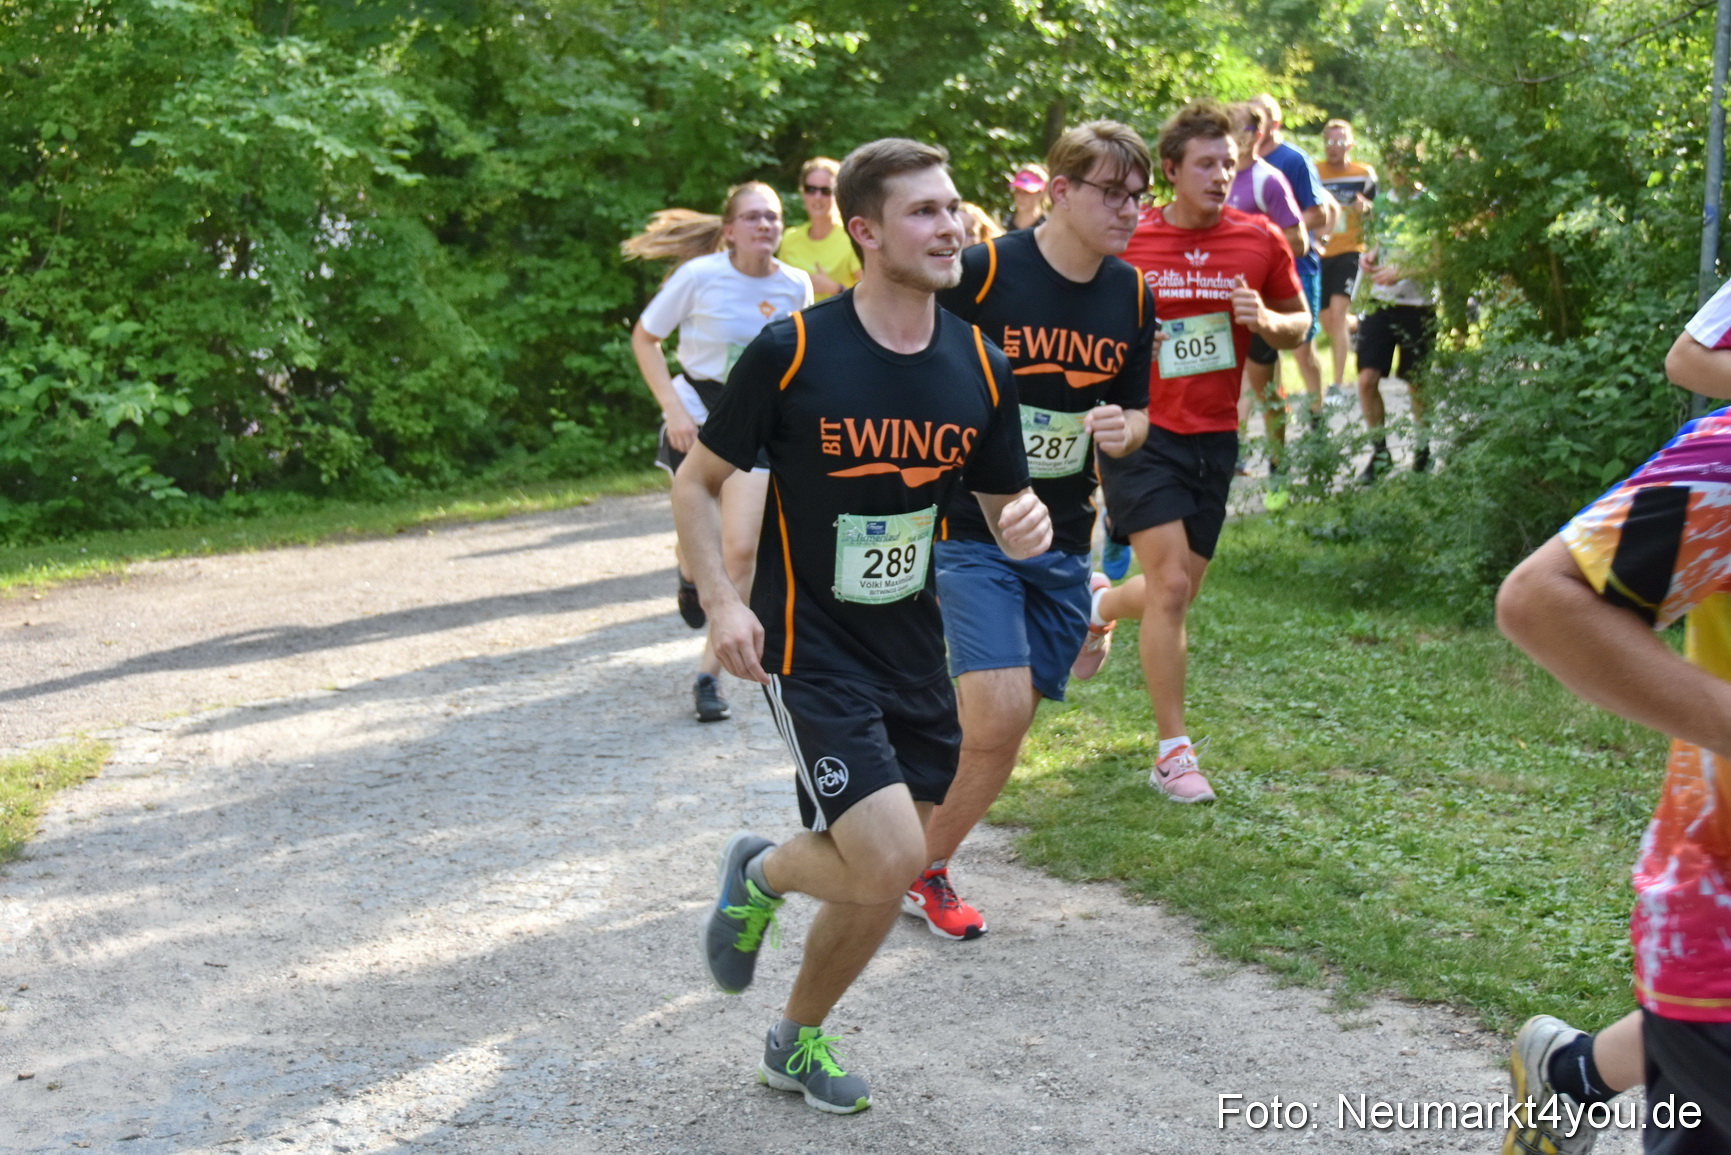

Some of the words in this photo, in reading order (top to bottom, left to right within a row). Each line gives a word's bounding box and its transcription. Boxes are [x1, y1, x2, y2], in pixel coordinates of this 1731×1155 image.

[1144, 269, 1185, 288] Echtes
[1159, 288, 1193, 299] IMMER
[1003, 325, 1021, 358] BIT
[1022, 326, 1128, 374] WINGS
[1174, 334, 1217, 360] 605
[820, 417, 842, 456] BIT
[843, 418, 978, 466] WINGS
[1026, 434, 1078, 460] 287
[862, 543, 917, 579] 289
[818, 769, 846, 791] FCN
